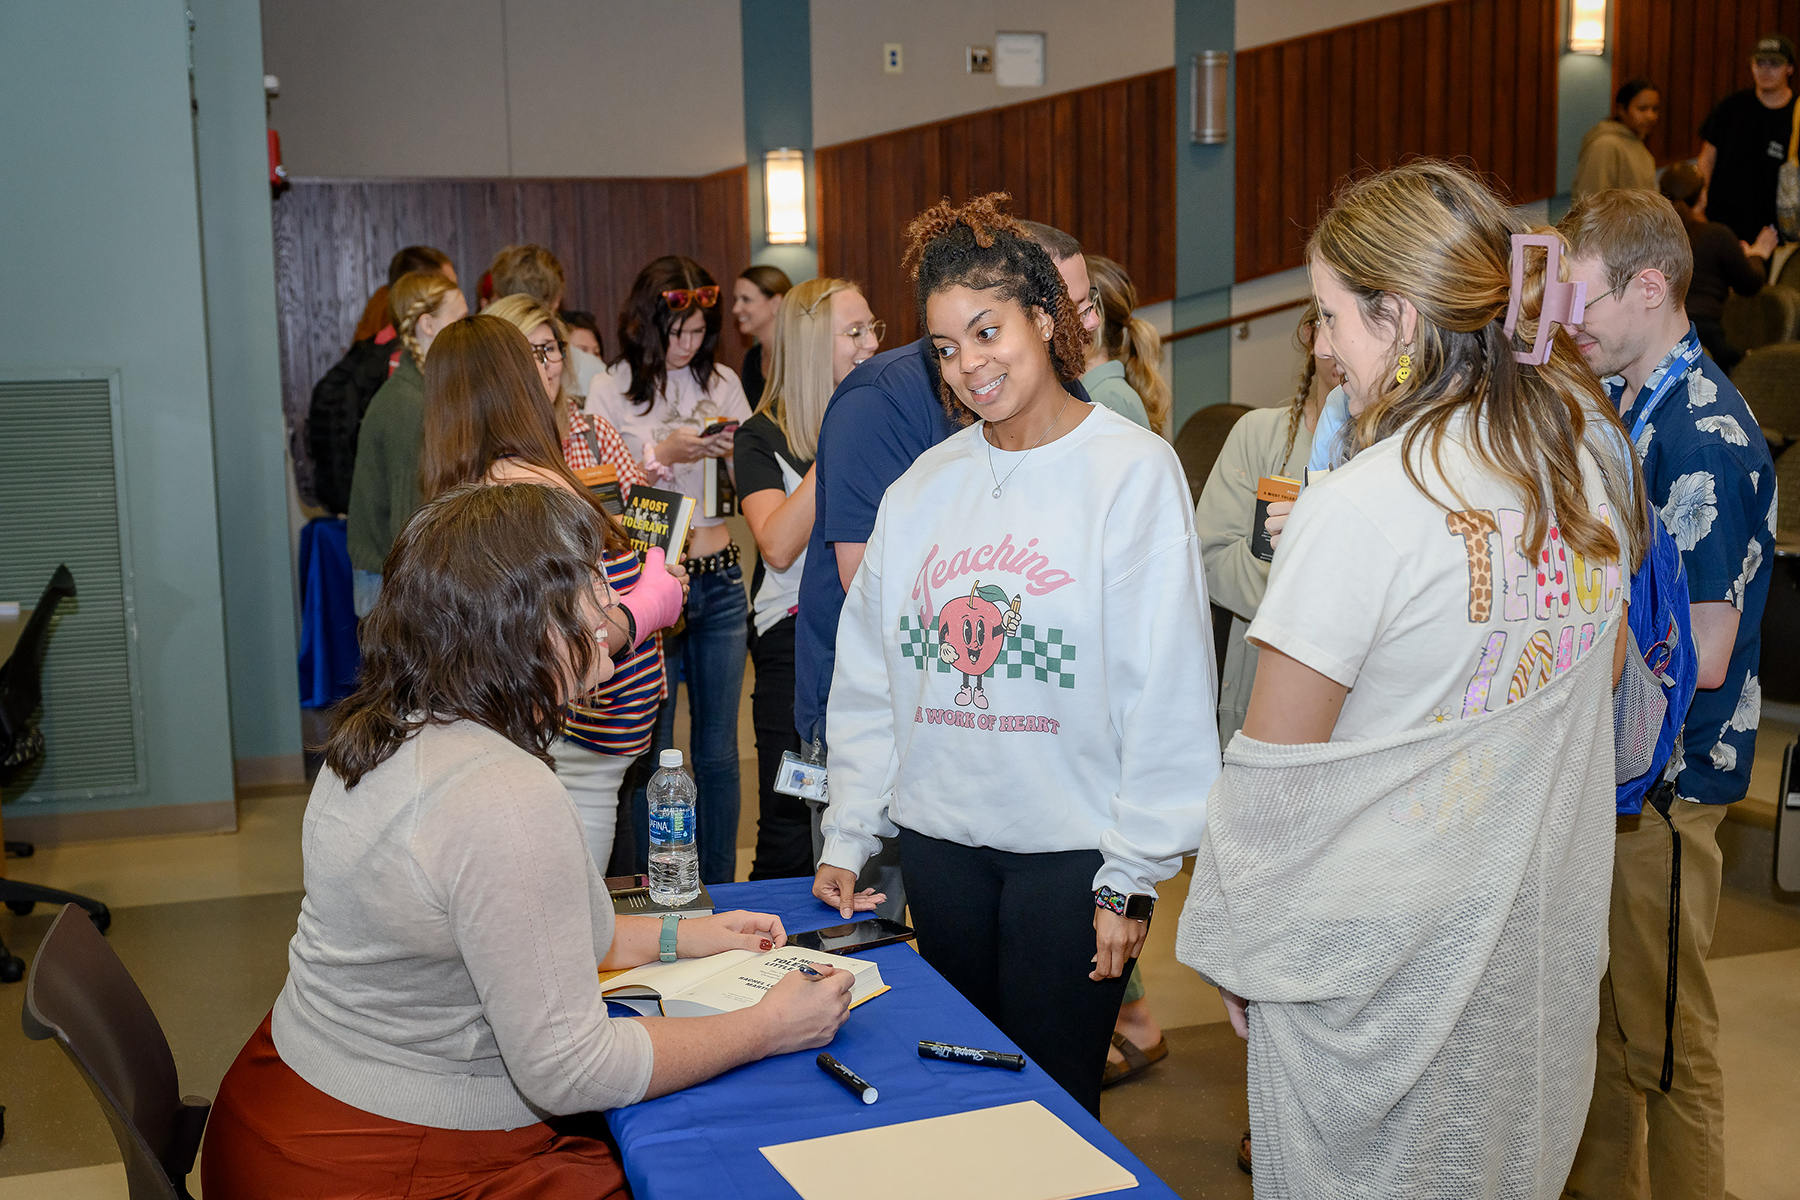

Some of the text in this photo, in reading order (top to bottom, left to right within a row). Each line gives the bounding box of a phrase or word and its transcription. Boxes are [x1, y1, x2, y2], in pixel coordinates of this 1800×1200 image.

[632, 496, 639, 508] A
[640, 497, 669, 514] MOST
[622, 515, 669, 536] TOLERANT
[630, 538, 656, 553] ITTL
[911, 533, 1077, 630] Teaching
[914, 706, 1061, 735] A WORK OF HEART
[764, 962, 795, 972] LITTLE
[773, 958, 801, 968] TOLE
[738, 976, 765, 986] RACHEL
